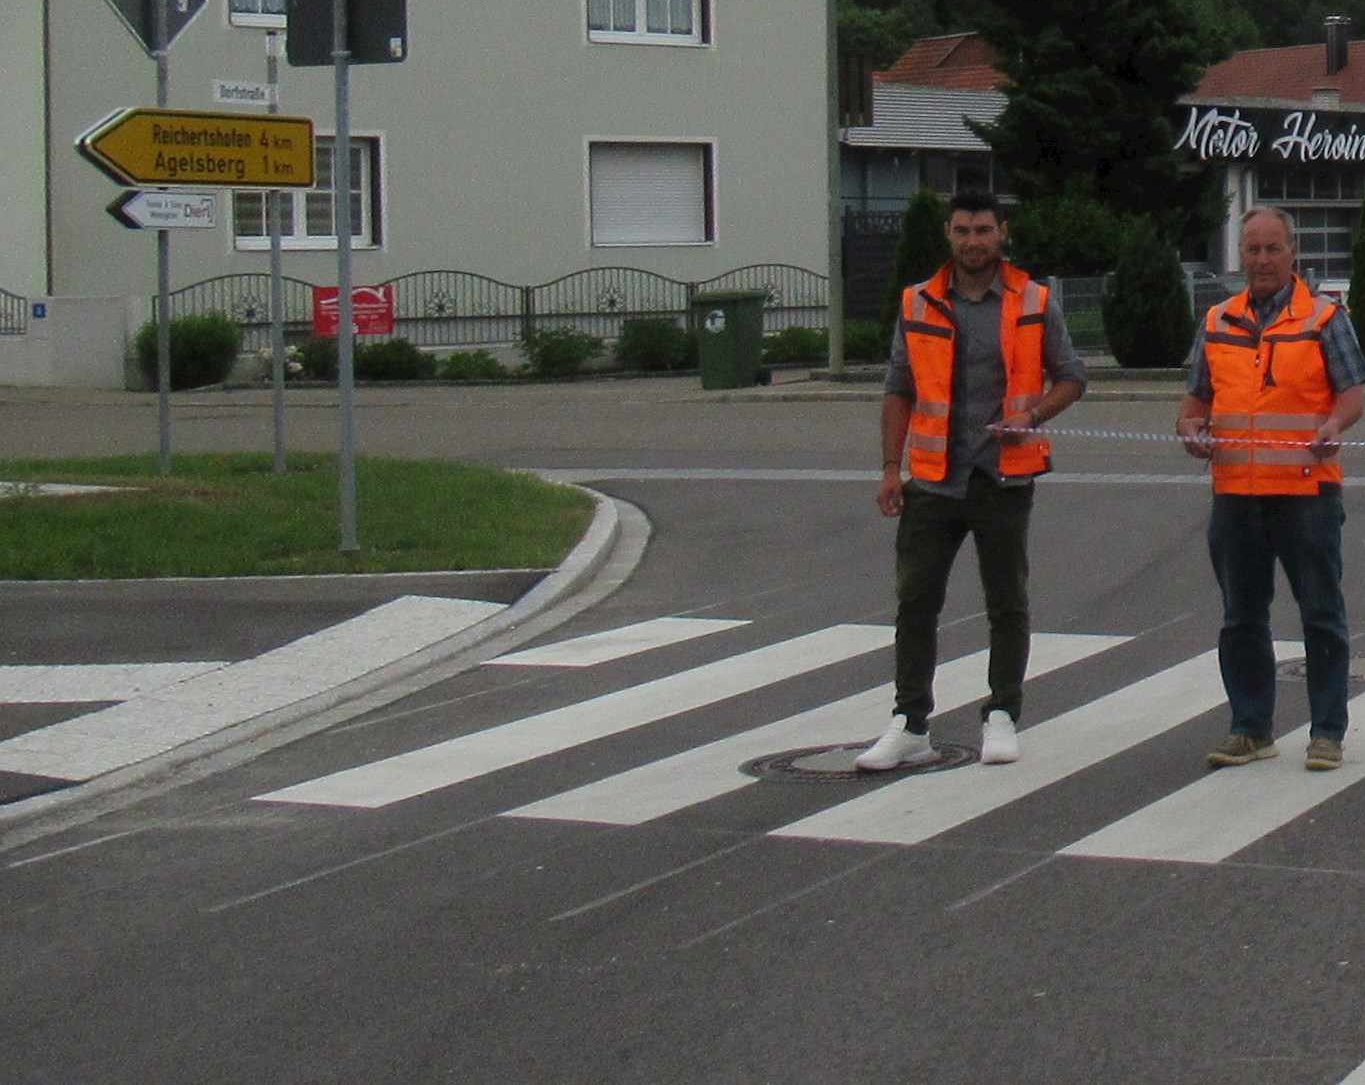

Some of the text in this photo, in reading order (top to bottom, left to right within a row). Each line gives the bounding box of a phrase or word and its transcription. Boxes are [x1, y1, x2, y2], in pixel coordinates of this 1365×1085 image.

[153, 123, 293, 150] Reichertshofen 4 km
[1173, 106, 1260, 161] Motor
[155, 151, 295, 179] Agelsberg 1 km
